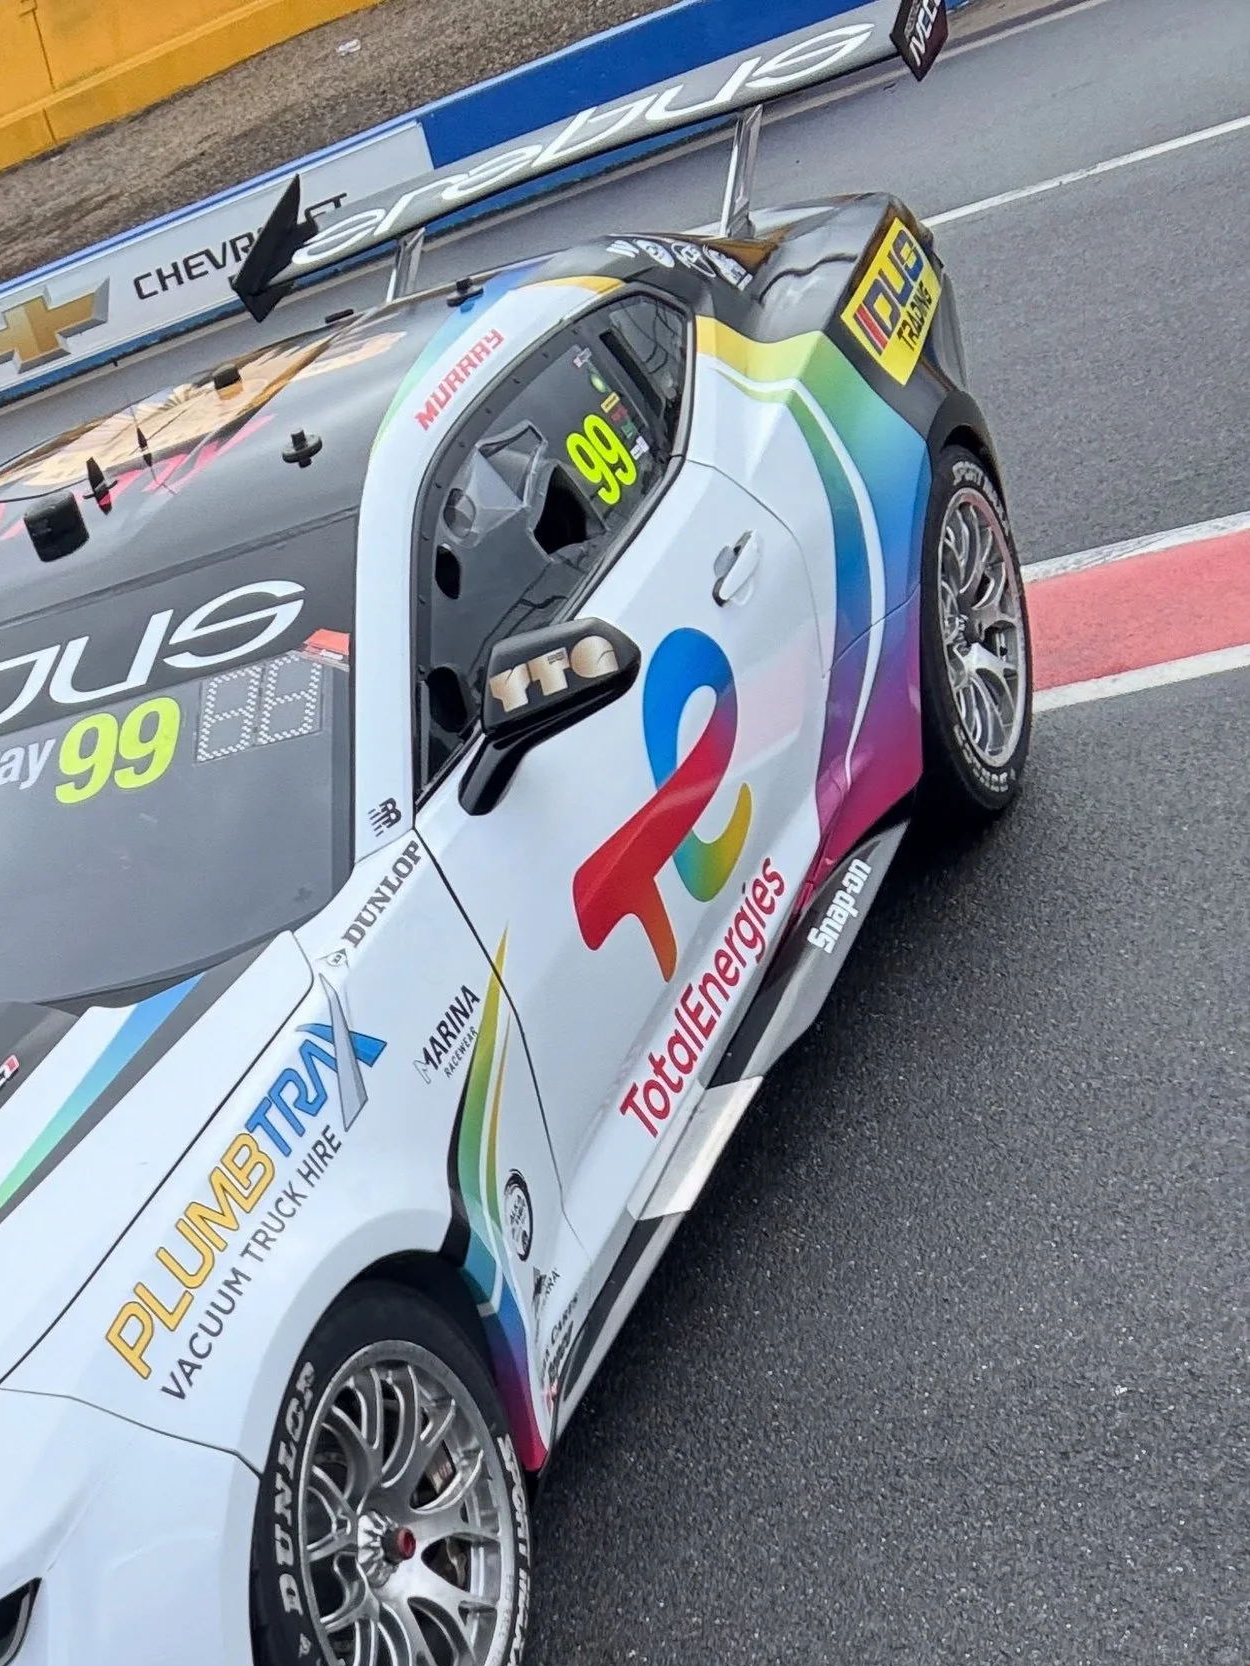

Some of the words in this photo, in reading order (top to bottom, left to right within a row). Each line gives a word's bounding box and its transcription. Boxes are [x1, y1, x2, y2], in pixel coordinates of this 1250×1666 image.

[292, 22, 877, 264] erebus
[414, 328, 505, 430] MURRAY
[566, 413, 638, 505] 99
[55, 697, 181, 804] 99
[340, 839, 422, 949] DUNLOP
[806, 858, 873, 954] Snap-on
[412, 984, 481, 1085] MARINA
[618, 855, 787, 1138] TotalEnergies
[158, 1265, 253, 1401] VACUUM
[239, 1178, 309, 1268] TRUCK
[302, 1123, 344, 1192] HIRE
